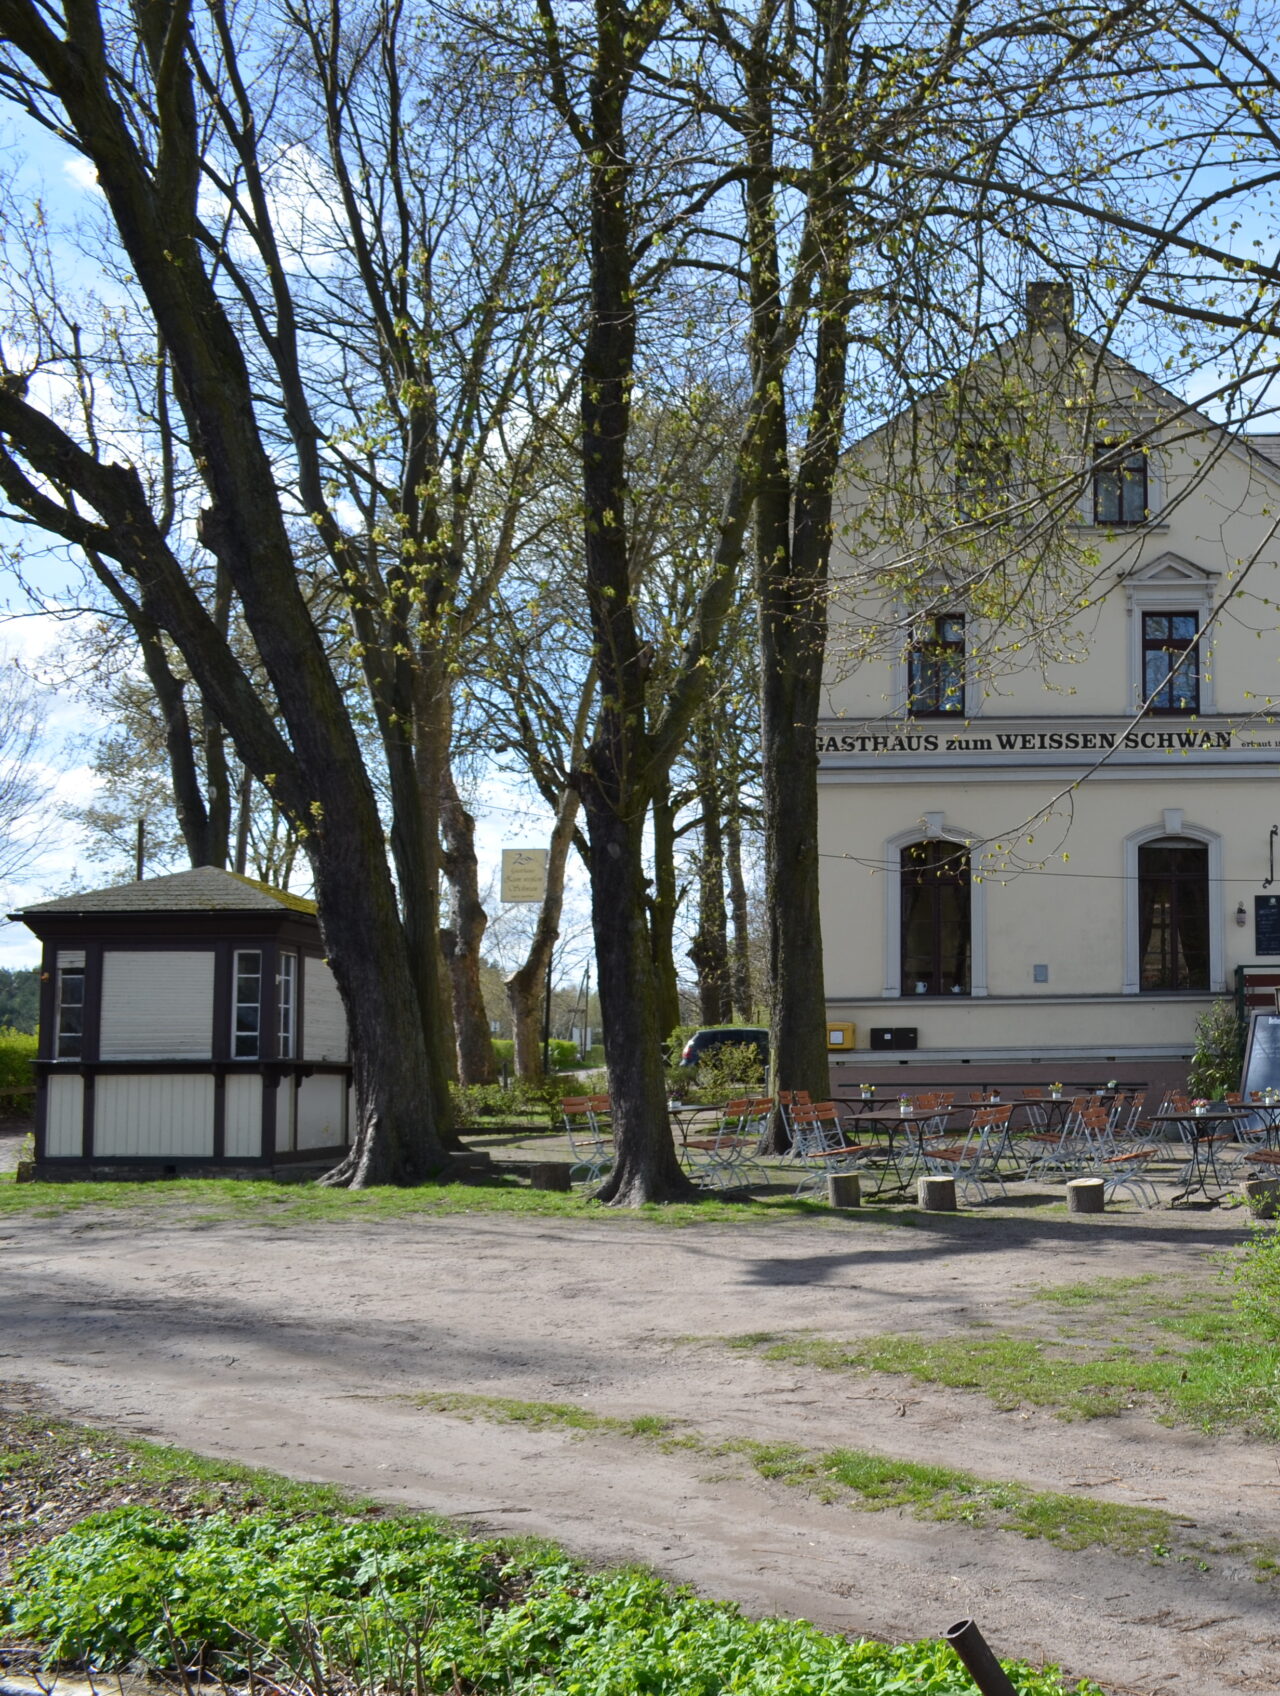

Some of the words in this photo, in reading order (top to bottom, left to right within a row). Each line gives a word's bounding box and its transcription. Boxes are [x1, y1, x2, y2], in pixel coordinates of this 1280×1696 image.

[815, 735, 938, 751] GASTHAUS
[946, 738, 992, 750] zum
[995, 732, 1117, 750] WEISSEN
[1125, 731, 1232, 748] SCHWAN
